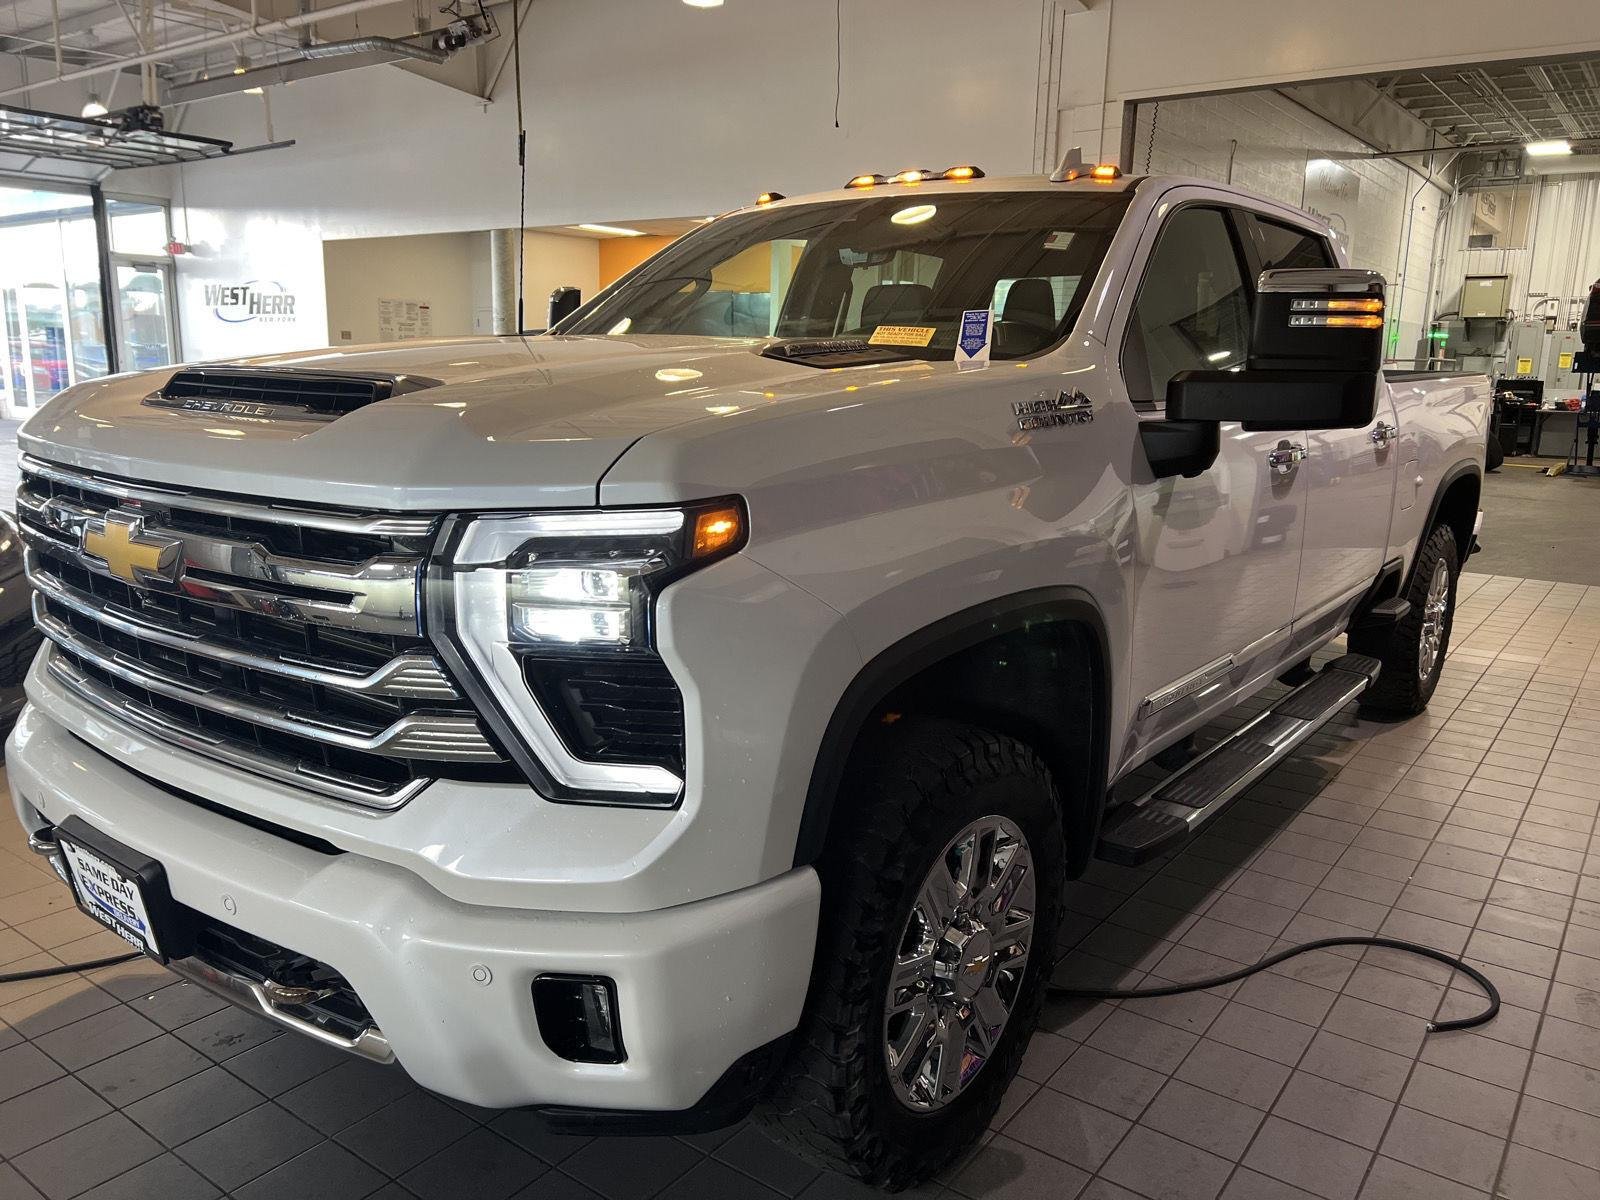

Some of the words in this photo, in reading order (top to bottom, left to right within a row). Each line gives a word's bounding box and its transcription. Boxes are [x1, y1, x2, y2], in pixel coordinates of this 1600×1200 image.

[204, 284, 250, 306] WEST
[249, 292, 296, 315] HERR
[77, 857, 110, 887] SAME
[111, 877, 134, 901] DAY
[81, 874, 136, 918] EXPRESS
[88, 903, 118, 929] WEST
[116, 923, 145, 950] HERR
